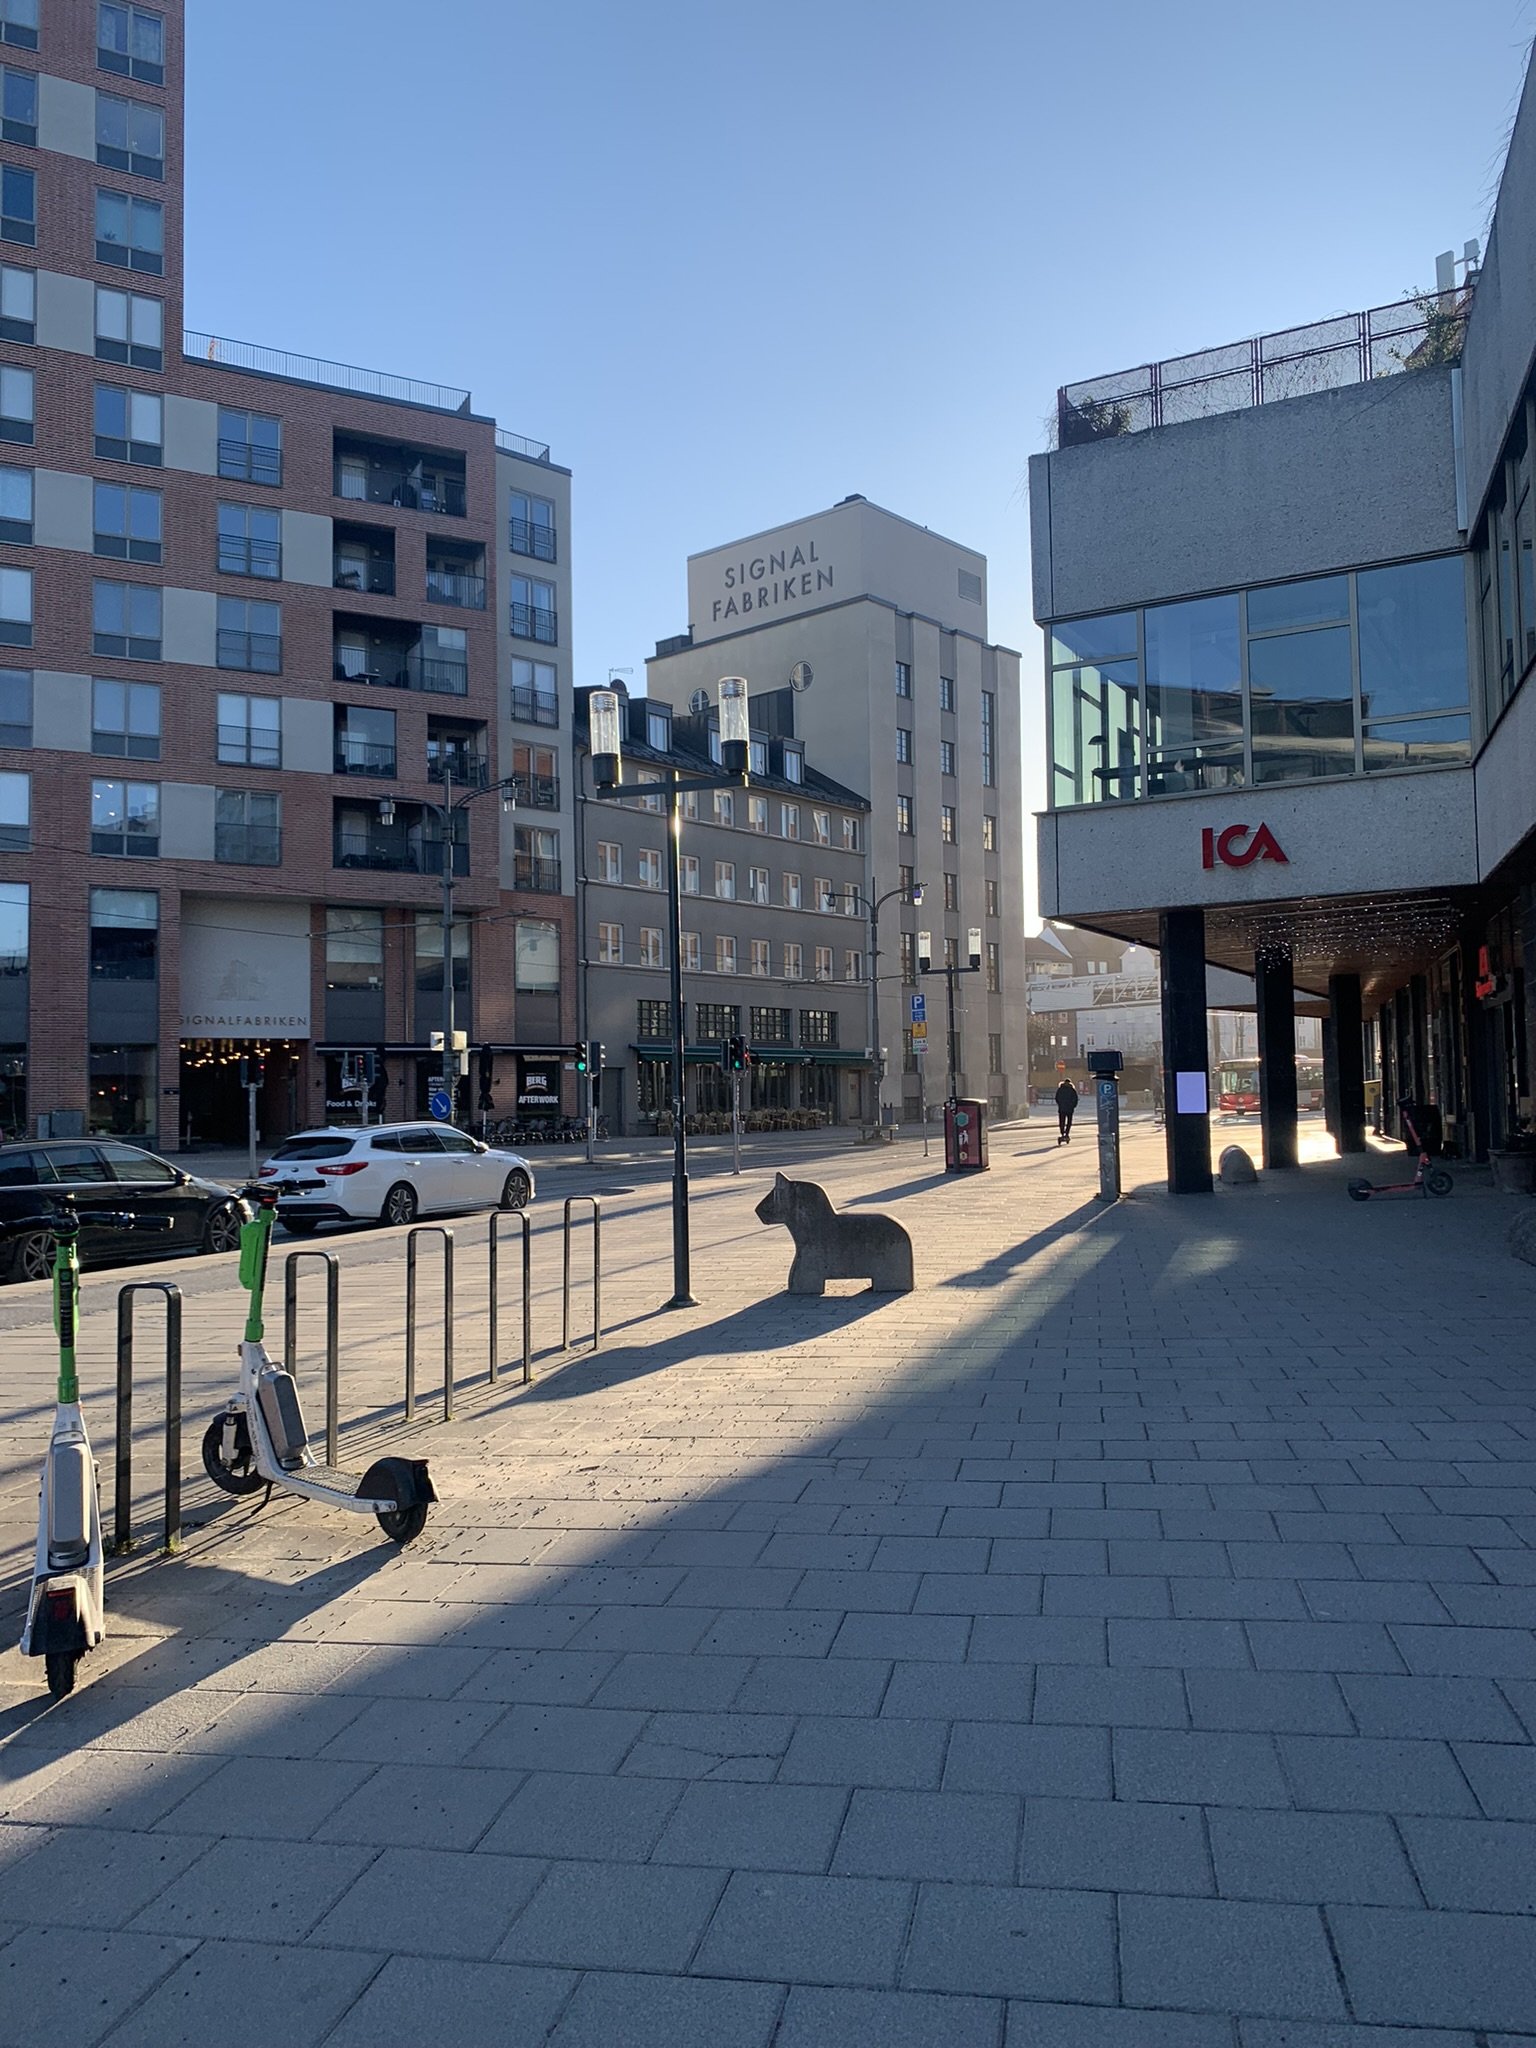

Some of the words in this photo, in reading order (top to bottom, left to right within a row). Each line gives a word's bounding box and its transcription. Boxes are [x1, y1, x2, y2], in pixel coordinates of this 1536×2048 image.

[725, 541, 818, 588] SIGNAL
[713, 565, 833, 621] FABRIKEN
[1202, 822, 1288, 868] ICA
[914, 996, 922, 1008] P
[526, 1076, 547, 1087] BERG
[1104, 1085, 1112, 1093] P
